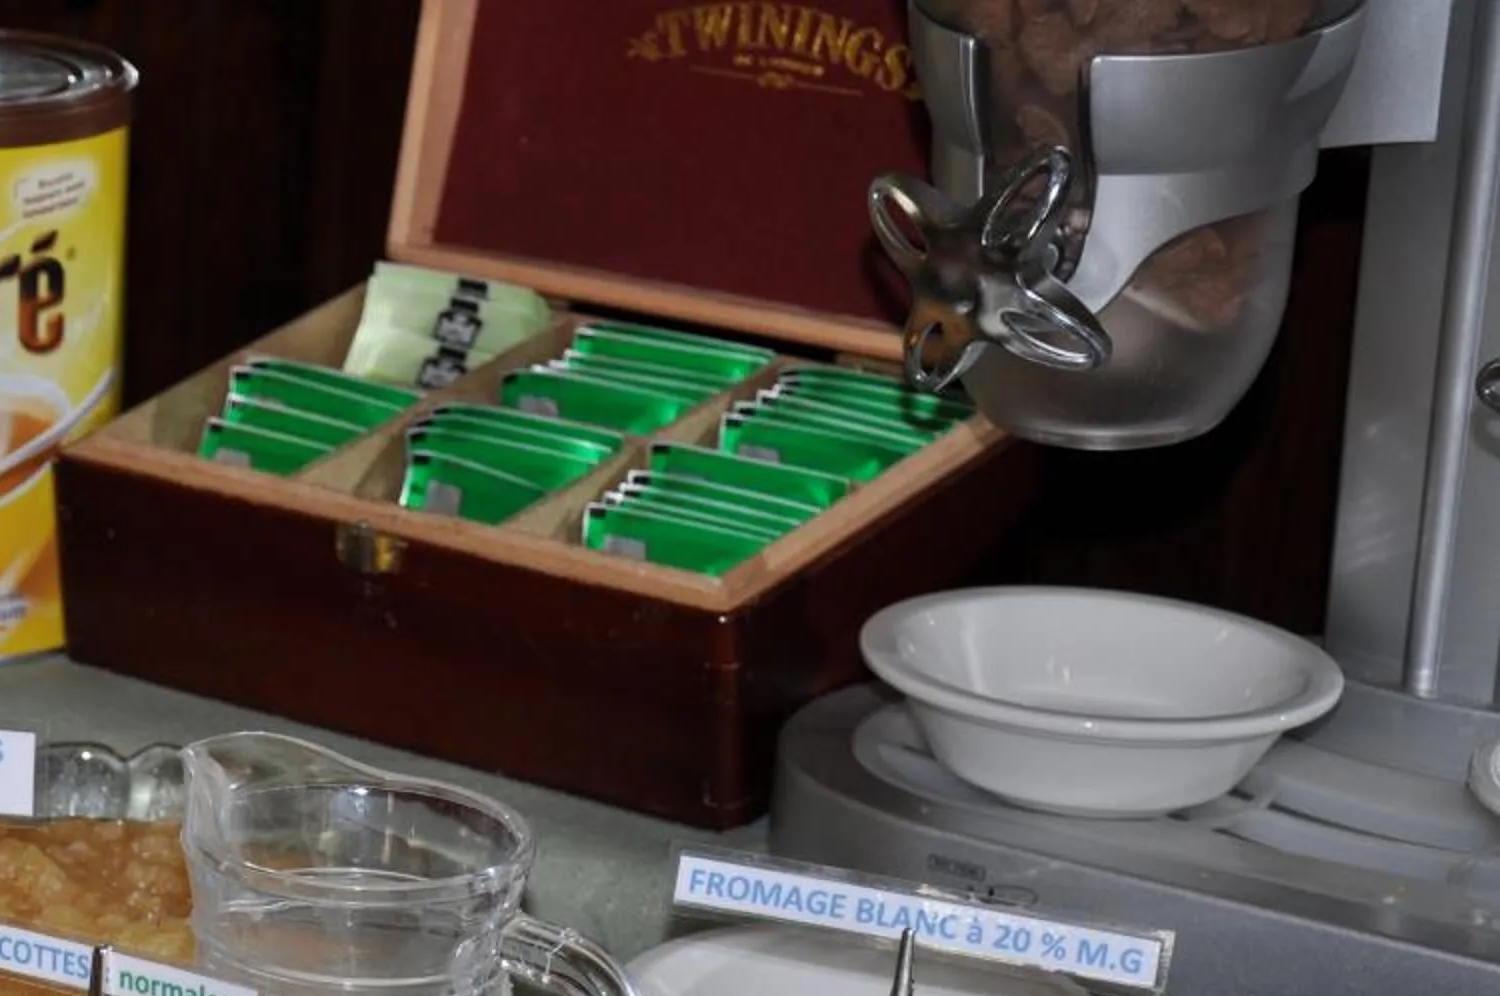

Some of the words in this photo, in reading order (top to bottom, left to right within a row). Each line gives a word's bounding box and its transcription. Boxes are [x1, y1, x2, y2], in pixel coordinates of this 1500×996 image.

[654, 3, 912, 91] TWININGS
[687, 868, 847, 920] FROMAGE
[854, 897, 956, 941] BLANC
[965, 915, 983, 945] à
[993, 923, 1032, 954] 20
[1039, 932, 1067, 962] %
[1075, 937, 1145, 976] M.G
